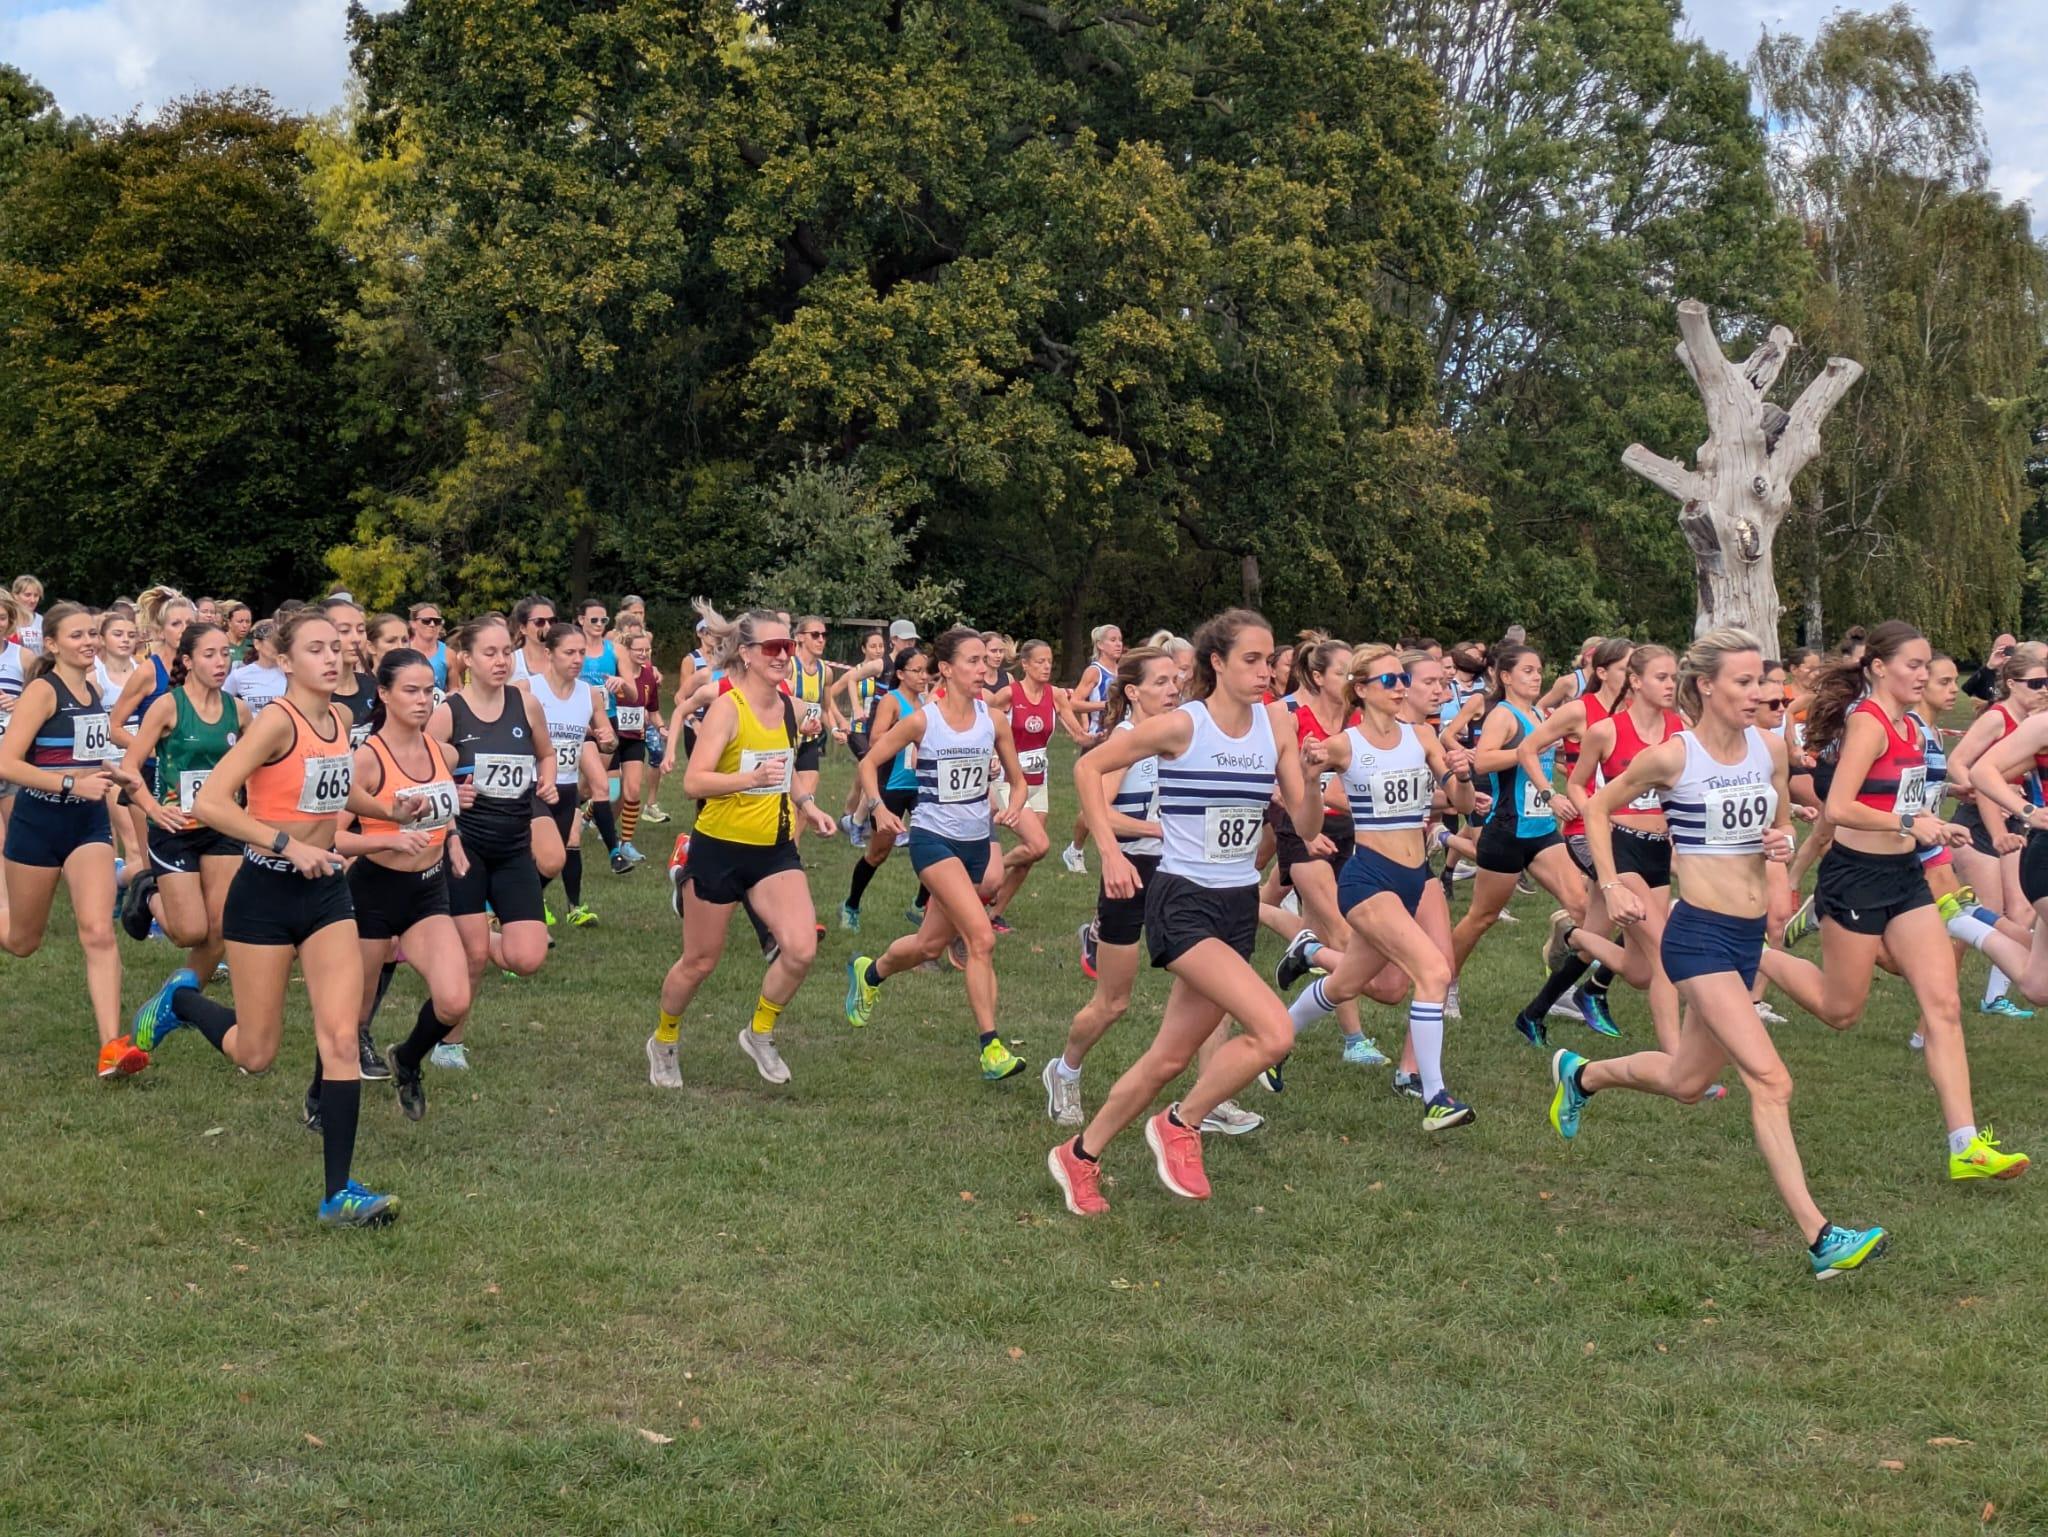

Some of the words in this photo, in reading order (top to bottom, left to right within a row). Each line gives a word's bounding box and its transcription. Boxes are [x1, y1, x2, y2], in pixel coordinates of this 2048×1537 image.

[620, 712, 641, 725] 859
[556, 747, 577, 766] 53
[936, 747, 980, 757] TONBRIDGE
[1211, 752, 1265, 770] TONBRIDGE
[316, 767, 351, 800] 663
[485, 764, 523, 787] 730
[950, 766, 983, 791] 872
[25, 787, 61, 803] NIKE
[1384, 777, 1419, 805] 881
[1722, 795, 1768, 830] 869
[1218, 818, 1262, 848] 887
[246, 848, 291, 872] NIKE
